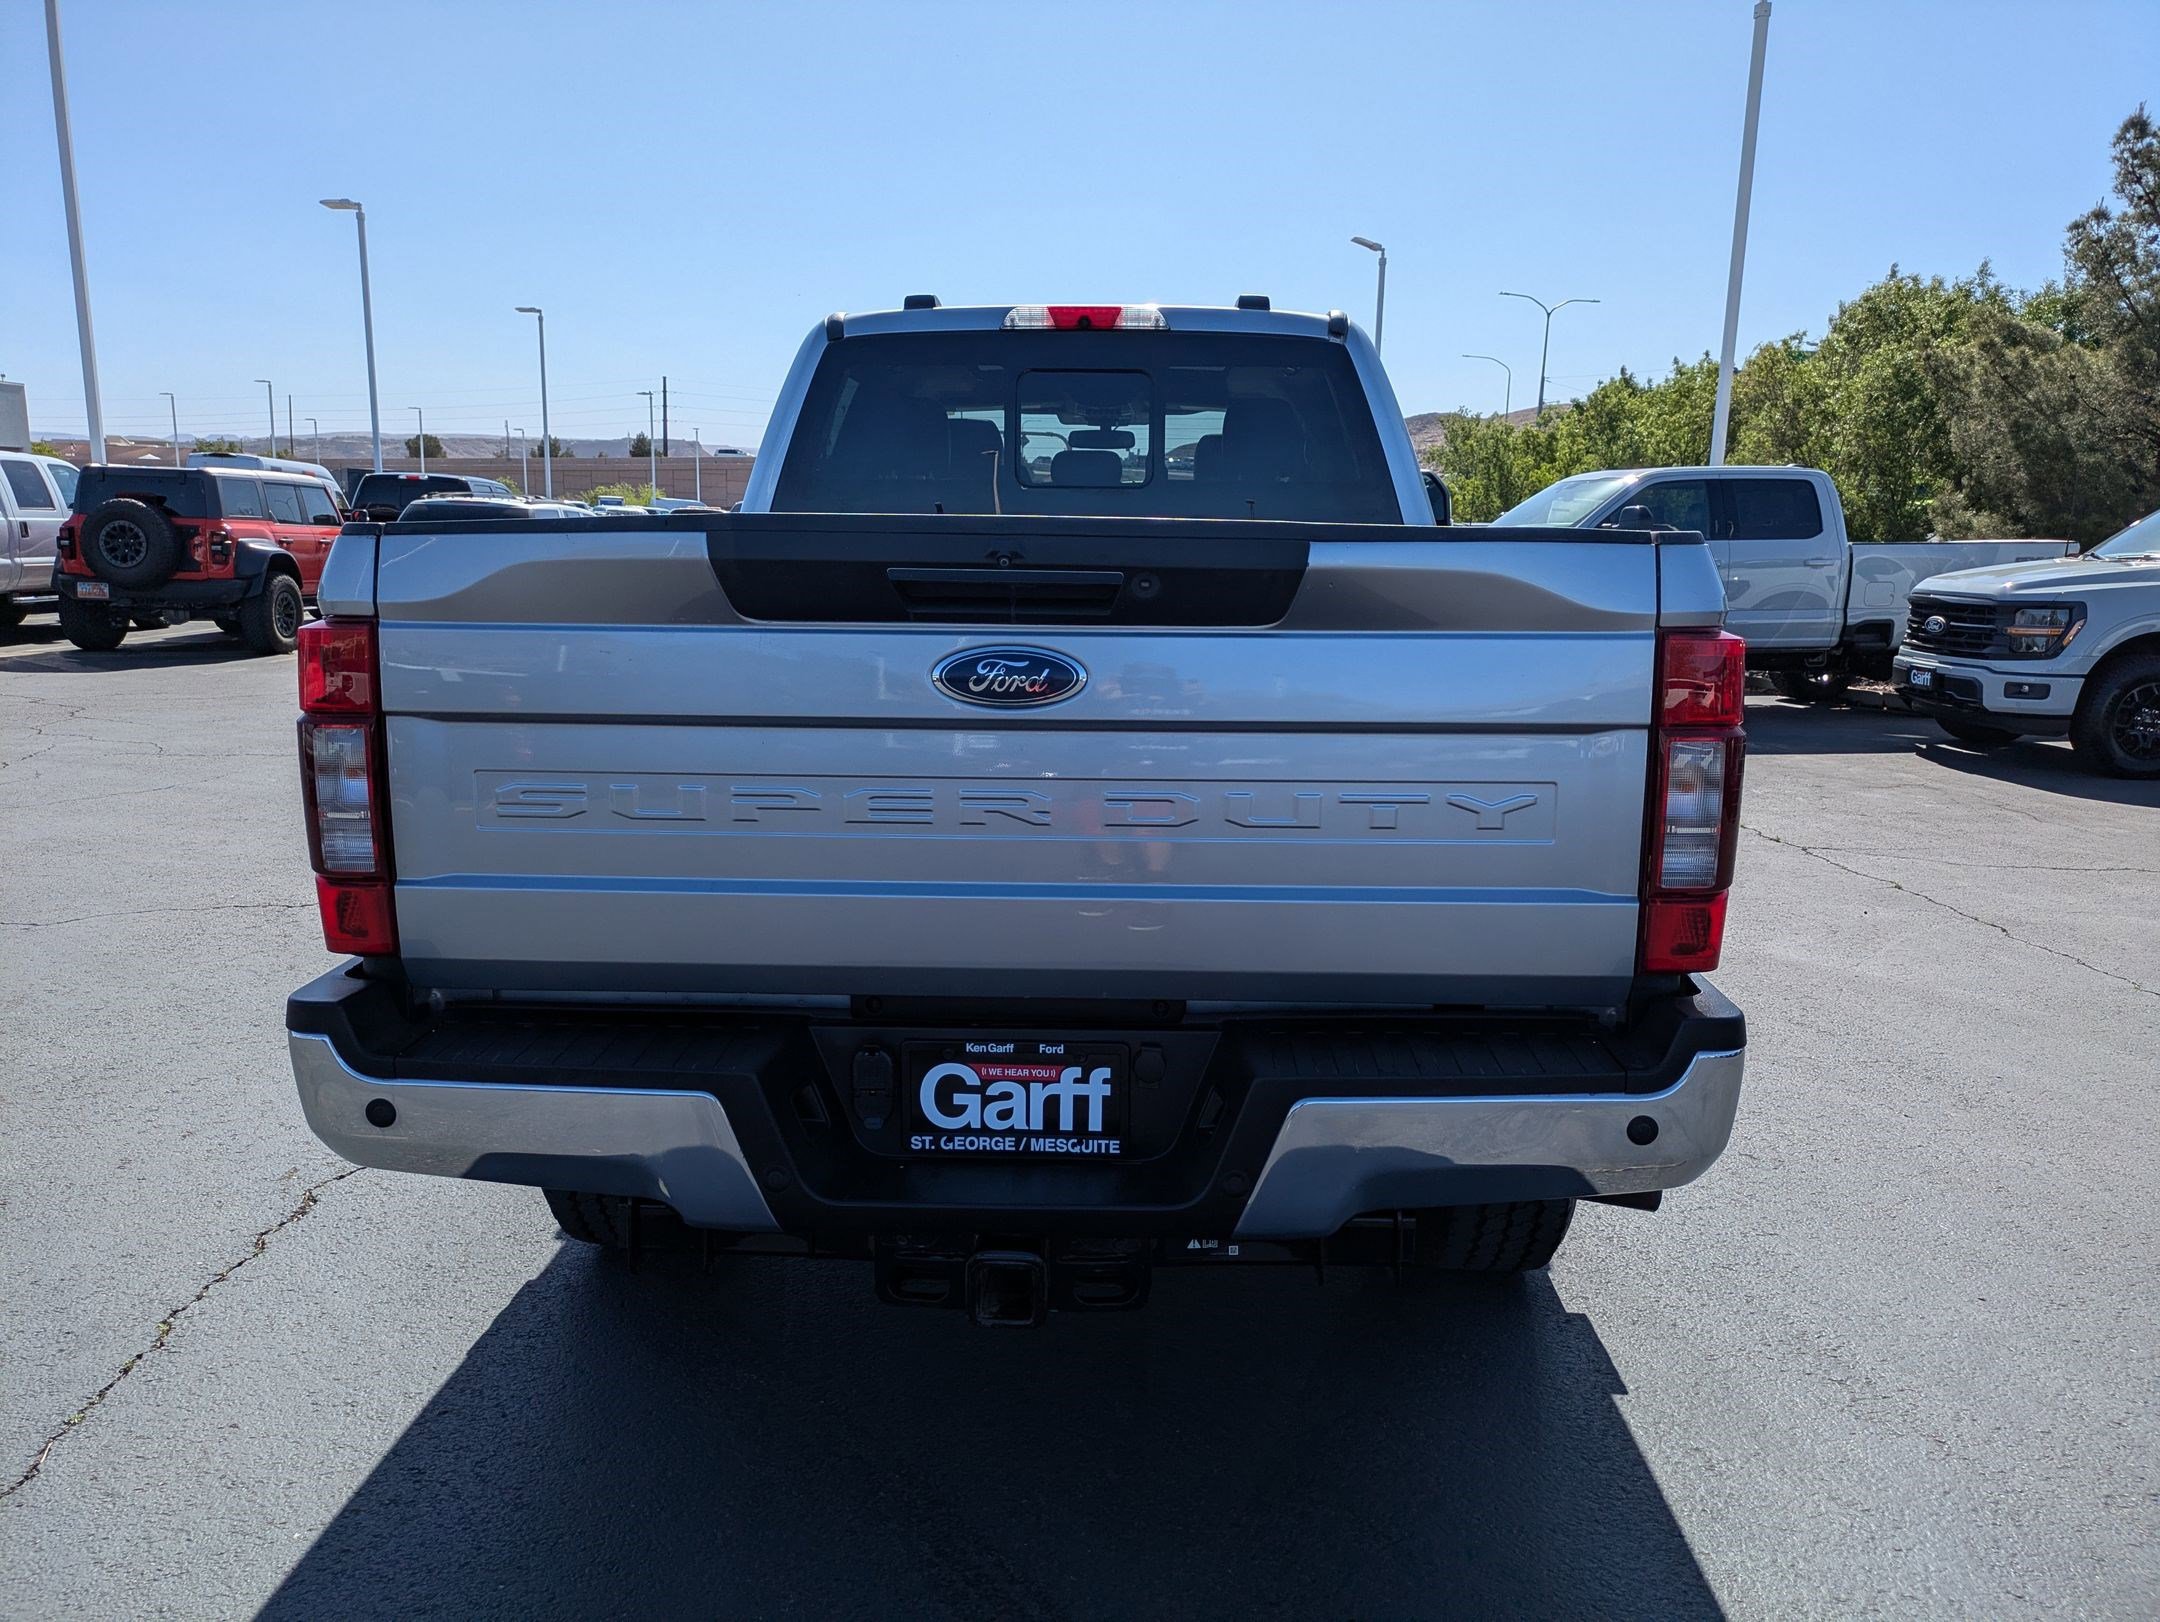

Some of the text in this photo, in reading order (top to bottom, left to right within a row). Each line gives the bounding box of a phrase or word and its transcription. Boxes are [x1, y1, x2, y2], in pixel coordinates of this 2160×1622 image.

[1927, 620, 1941, 631] Ford
[968, 658, 1050, 693] Ford
[1910, 669, 1932, 686] Garff
[496, 783, 1539, 830] SUPER DUTY
[965, 1042, 1064, 1054] Ken Garff Ford
[988, 1068, 1050, 1078] WE HEAR YOU
[919, 1062, 1112, 1132] Garff
[910, 1135, 936, 1150] ST.
[940, 1136, 1016, 1151] GEORGE
[1030, 1138, 1121, 1154] MESQUITE
